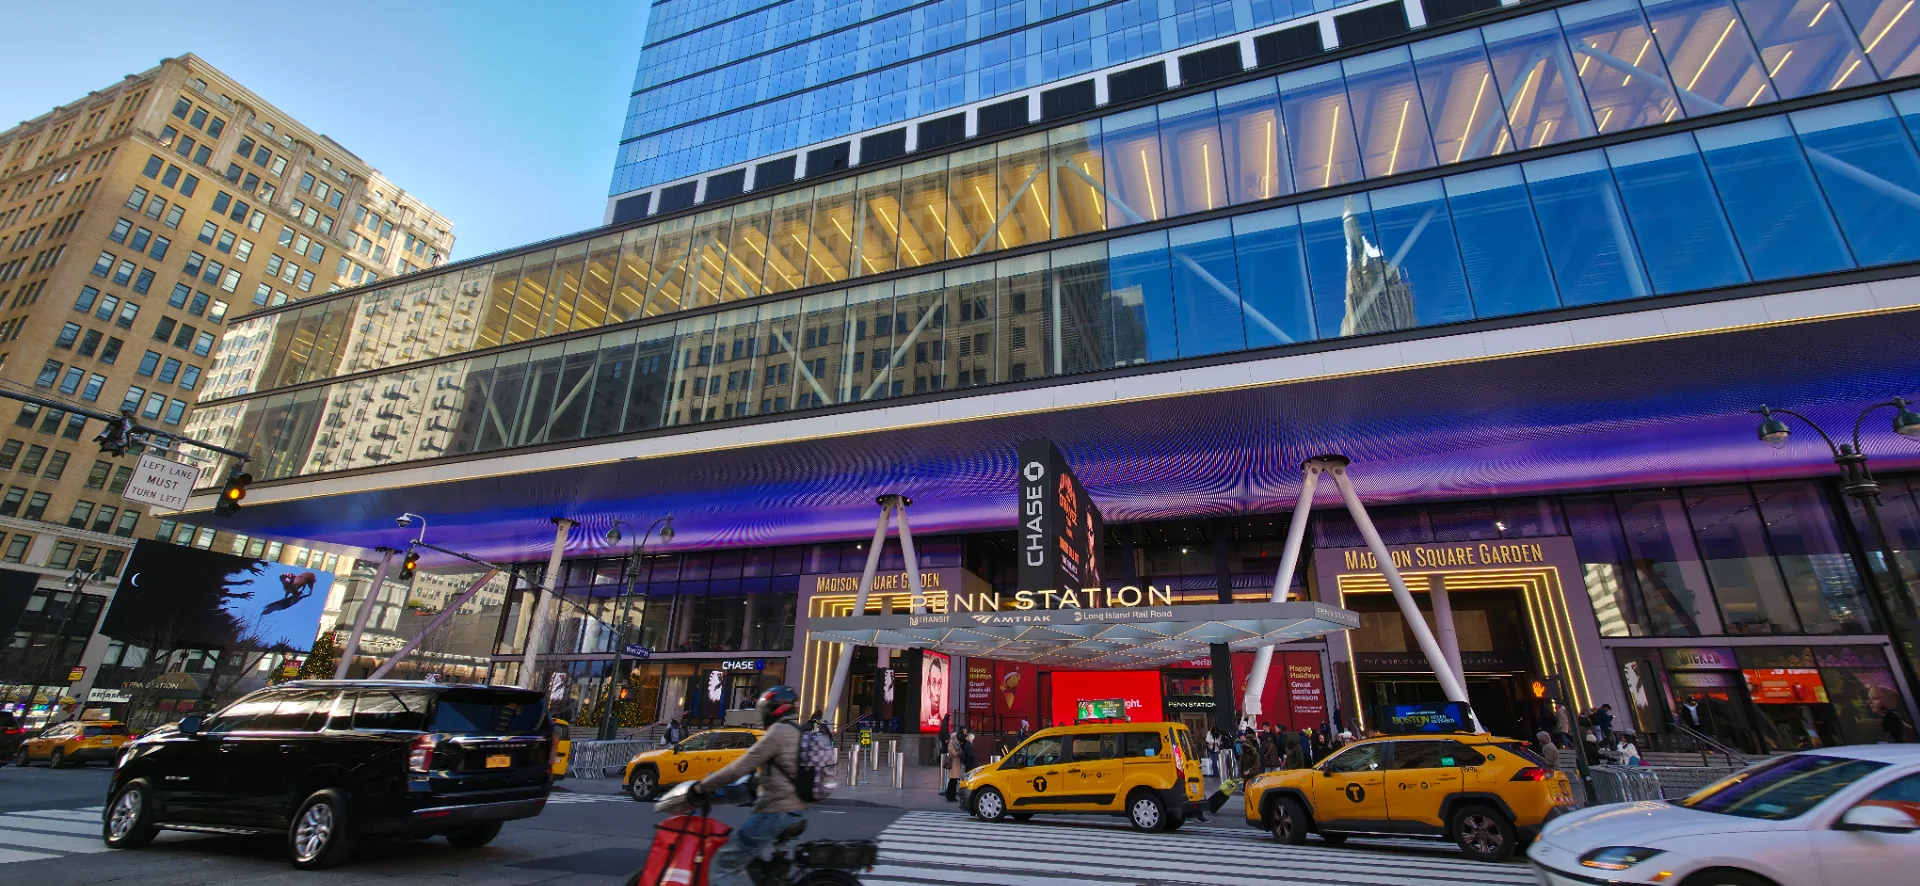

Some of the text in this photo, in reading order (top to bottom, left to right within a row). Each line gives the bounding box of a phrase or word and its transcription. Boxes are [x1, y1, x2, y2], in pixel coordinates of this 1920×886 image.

[143, 460, 192, 480] LEFT LANE
[146, 475, 179, 490] MUST
[131, 486, 183, 505] TURN LEFT
[1026, 485, 1044, 567] CHASE
[1344, 543, 1544, 570] MADON SQUARE GARDEN
[817, 577, 859, 593] MADISON
[901, 572, 940, 589] GDEN
[909, 584, 1172, 614] PENN STATION
[919, 616, 950, 624] TRANSIT
[992, 615, 1051, 623] AMTRAK
[1083, 610, 1173, 621] Long Island Rail Road
[1317, 607, 1357, 623] PENN STATION
[722, 660, 754, 670] CHASE
[1392, 715, 1430, 727] BOSTON
